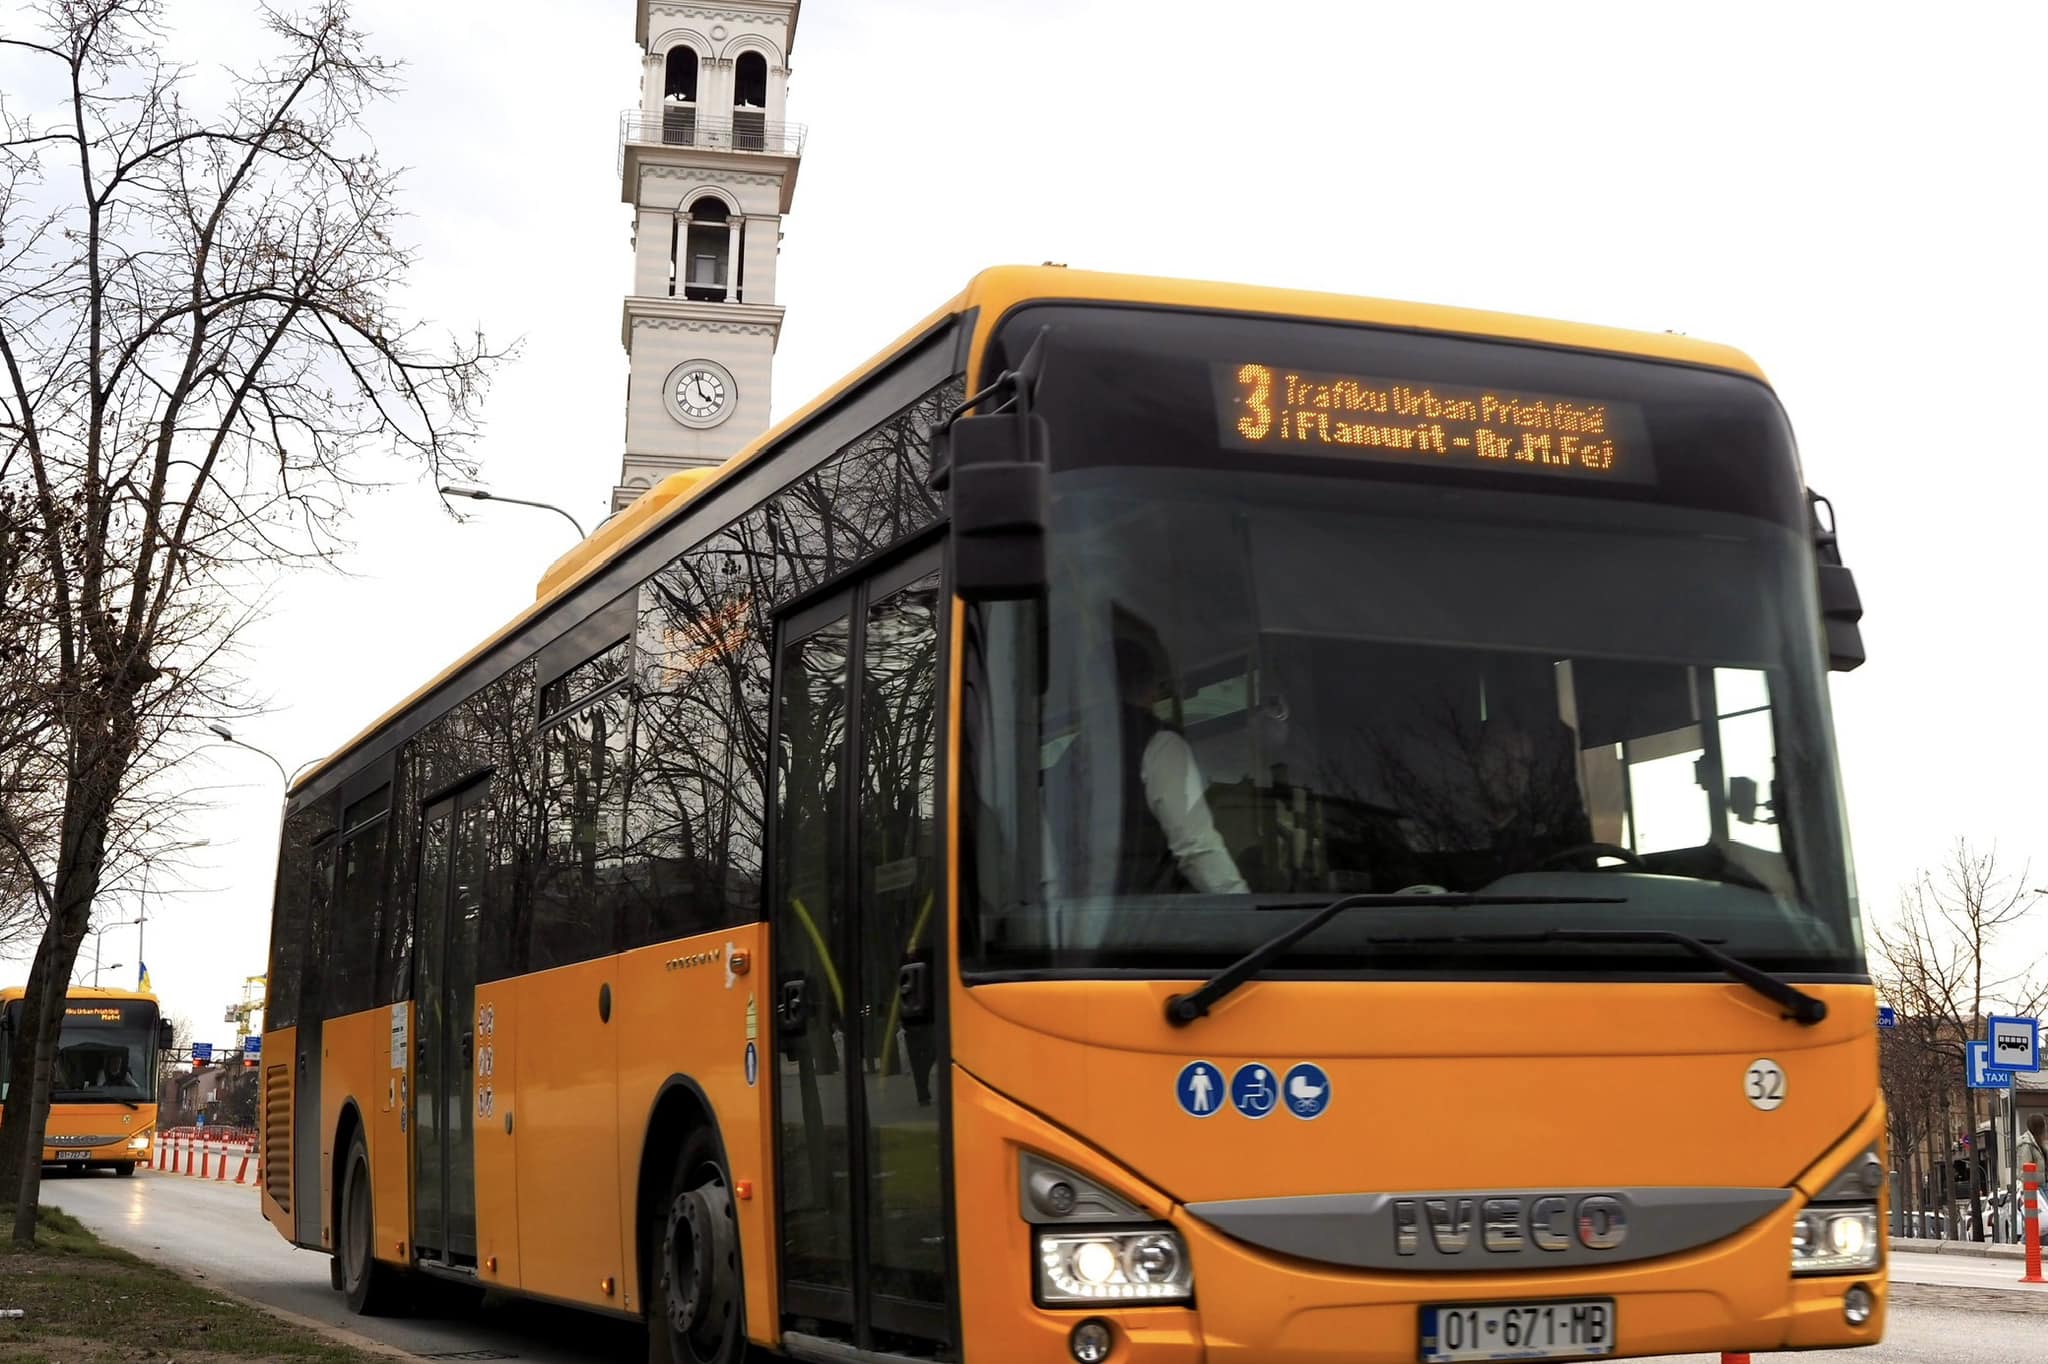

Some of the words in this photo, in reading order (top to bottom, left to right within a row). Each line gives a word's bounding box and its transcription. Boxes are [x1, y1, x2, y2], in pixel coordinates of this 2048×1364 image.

[1238, 364, 1271, 439] 3
[1284, 375, 1388, 413] Trafiku
[1392, 386, 1477, 421] Urban
[1296, 411, 1447, 453] Flamurit
[1748, 1070, 1784, 1100] 32
[1985, 1073, 2008, 1082] TAXI
[1393, 1196, 1628, 1256] IVECO
